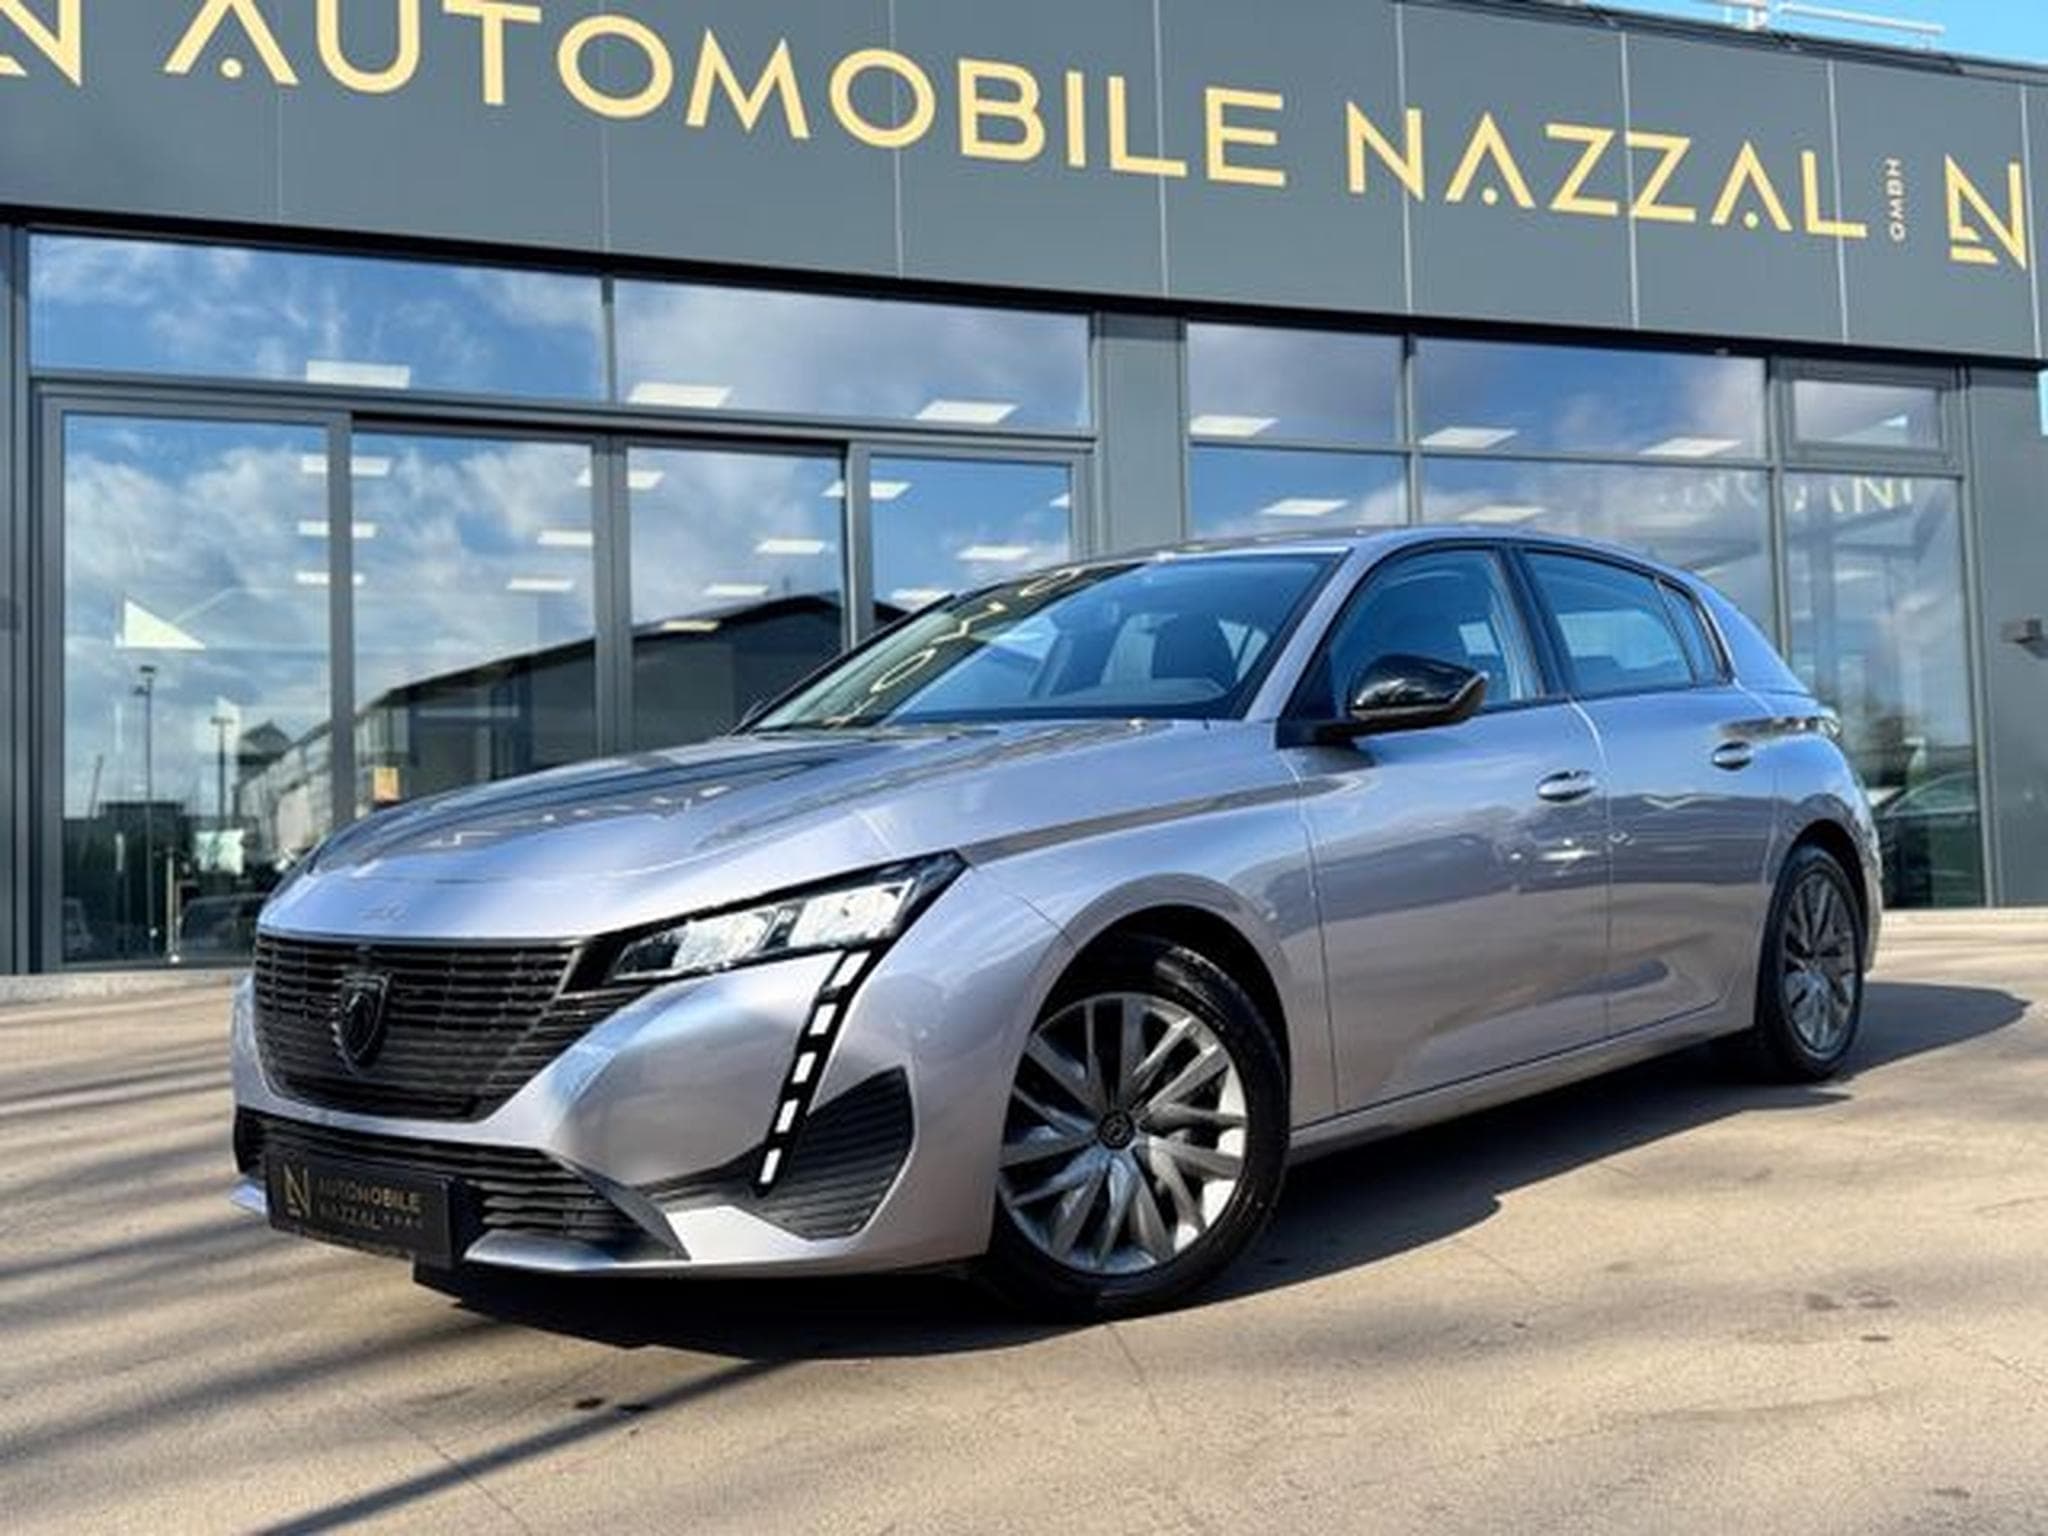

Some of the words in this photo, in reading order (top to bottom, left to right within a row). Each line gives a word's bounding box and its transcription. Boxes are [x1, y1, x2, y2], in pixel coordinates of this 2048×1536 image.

[163, 0, 1287, 187] AUTOMOBILE
[1345, 101, 1868, 239] NAZZAL
[1885, 157, 1906, 242] GMBH
